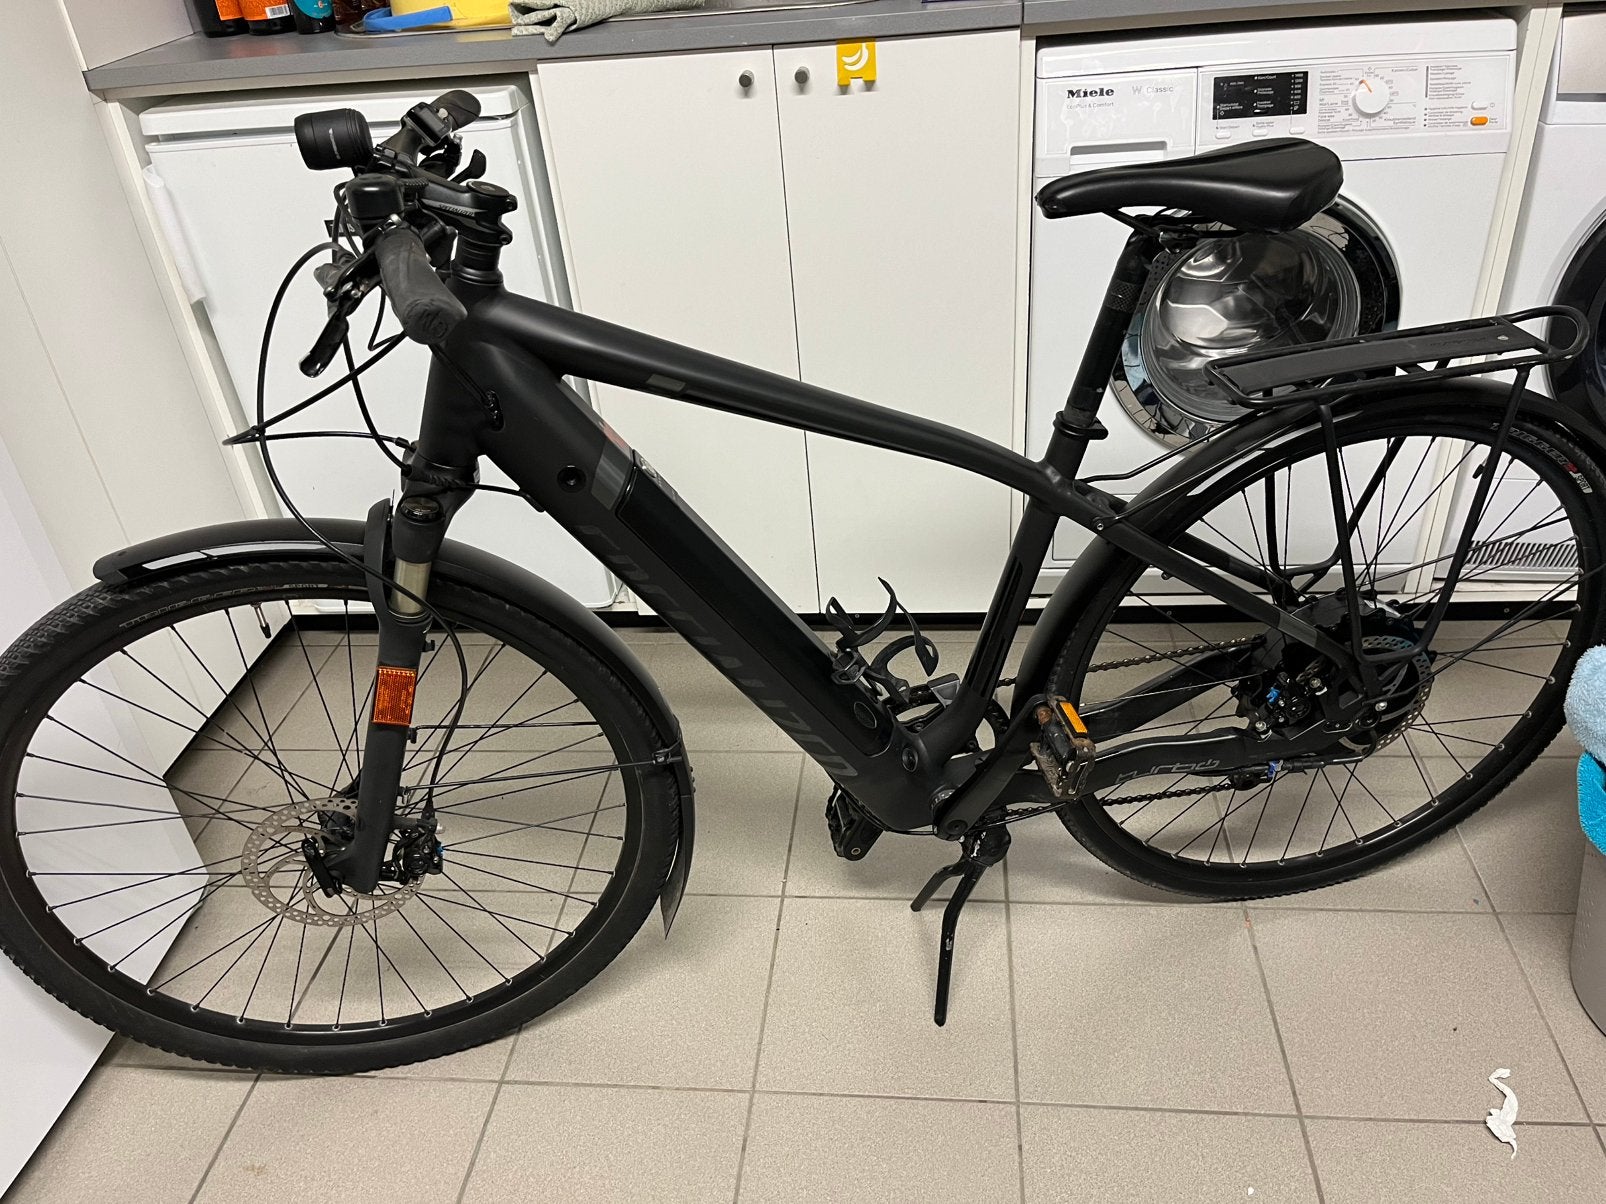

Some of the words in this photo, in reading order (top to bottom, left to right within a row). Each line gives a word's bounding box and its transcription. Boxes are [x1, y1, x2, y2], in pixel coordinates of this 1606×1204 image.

[1066, 87, 1115, 99] Miele
[1132, 85, 1142, 95] W
[1146, 86, 1174, 94] Classic
